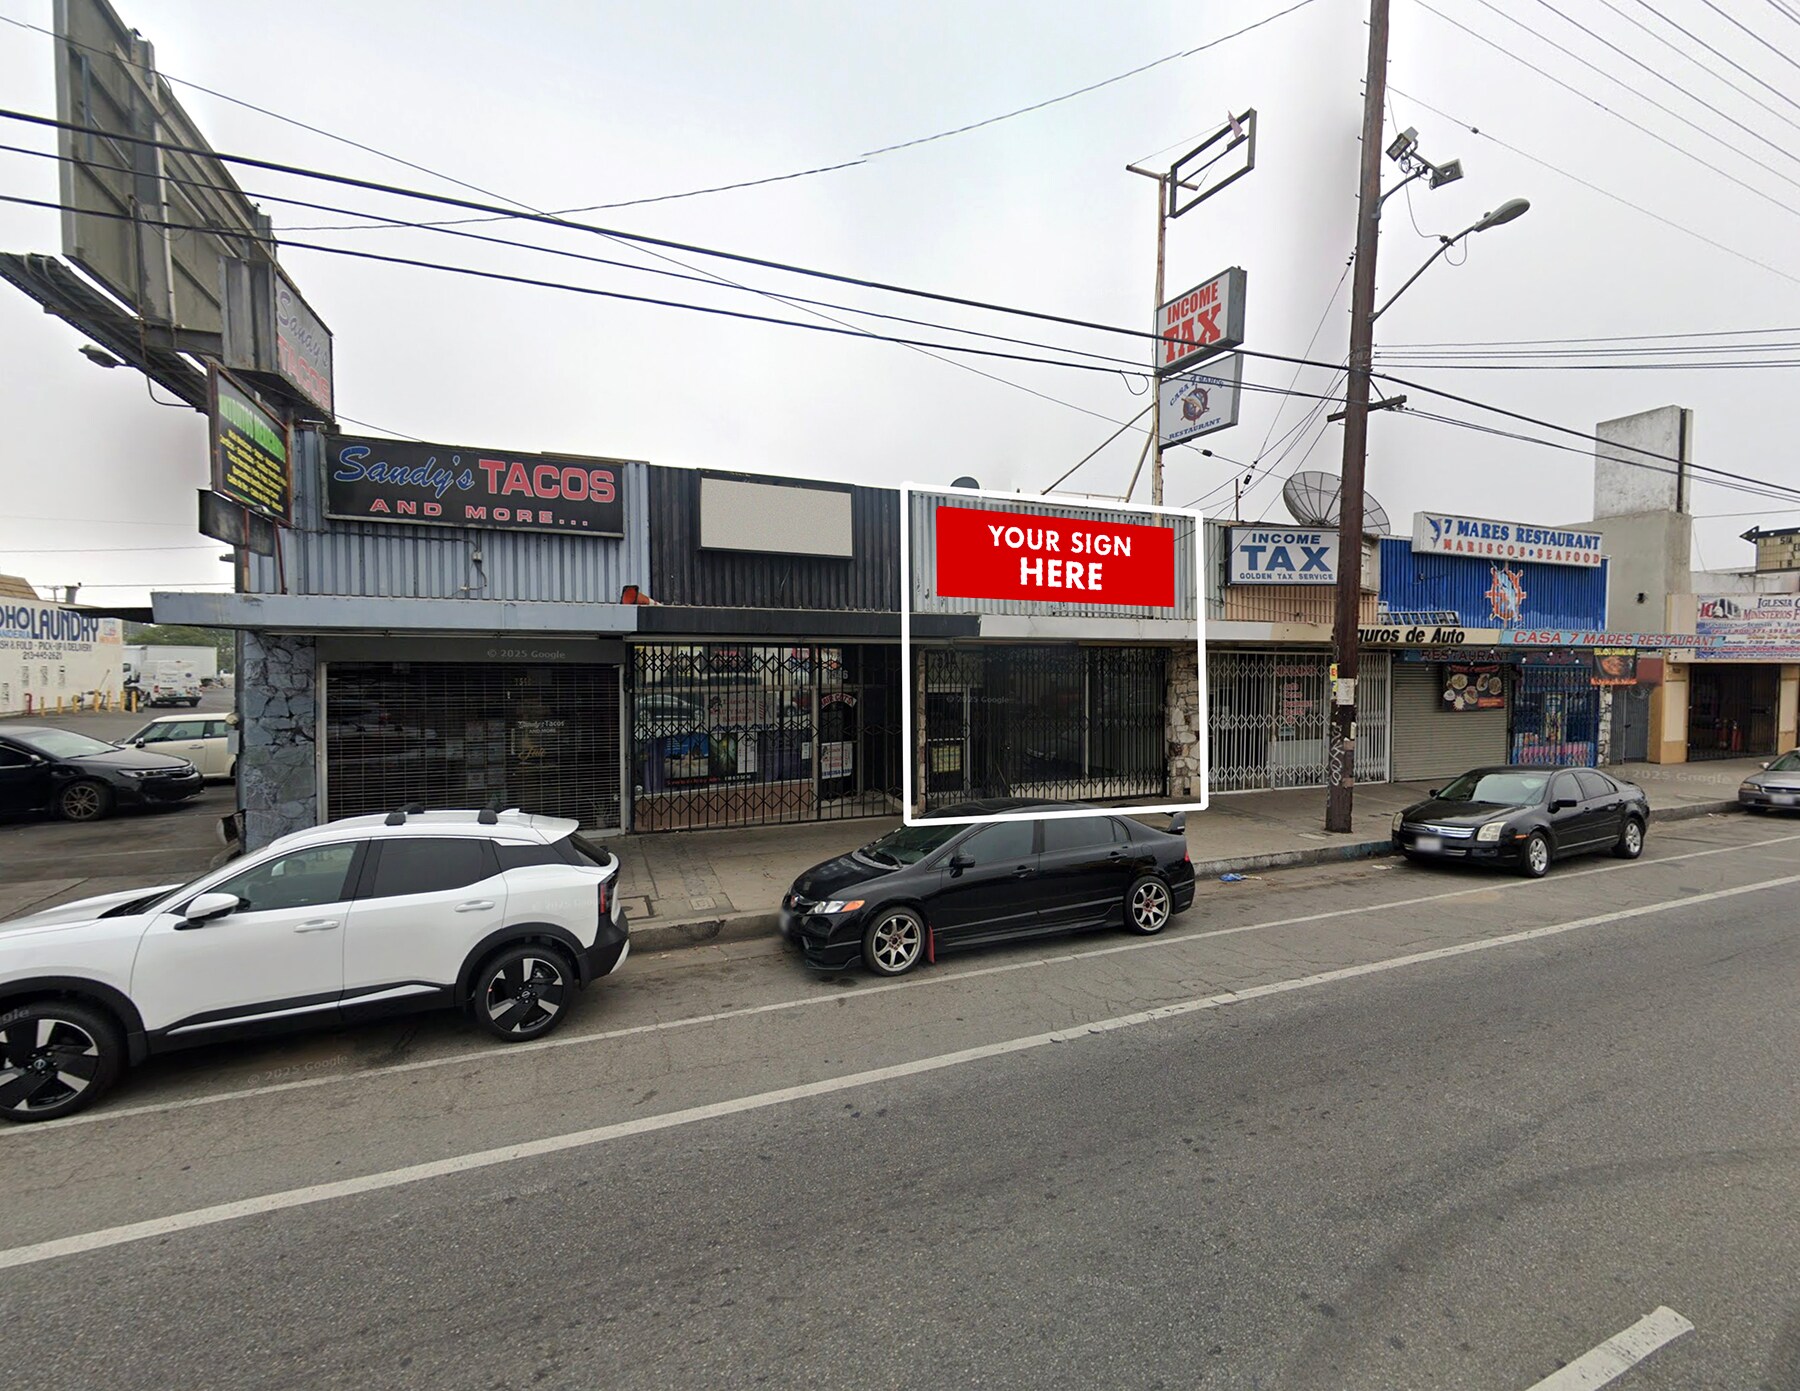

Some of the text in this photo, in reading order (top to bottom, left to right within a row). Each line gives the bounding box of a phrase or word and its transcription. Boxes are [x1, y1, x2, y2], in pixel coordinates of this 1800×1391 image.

[1167, 281, 1219, 325] INCOME
[1163, 303, 1222, 363] TAX
[278, 334, 331, 411] TACOS
[1170, 383, 1190, 406] CASA
[1168, 417, 1222, 440] RESTAURANT
[334, 446, 475, 498] Sandy's
[479, 458, 617, 503] TACOS
[370, 498, 589, 527] AND MORE...
[1252, 533, 1321, 545] INCOME
[1444, 519, 1601, 550] 7 MARES RESTAURANT
[1240, 545, 1332, 572] TAX
[1444, 538, 1601, 564] MARISCOS SEAFOOD
[1240, 572, 1273, 580] GOLDEN
[1743, 608, 1793, 620] MINISTERIOS
[1757, 598, 1792, 609] IGLESIA
[31, 608, 100, 642] LAUNDRY
[1357, 626, 1466, 645] guros de Auto
[16, 641, 33, 651] FOLD
[1514, 631, 1718, 647] CASA 7 MARES RESTAURANT
[1421, 649, 1511, 662] RESTAURANT
